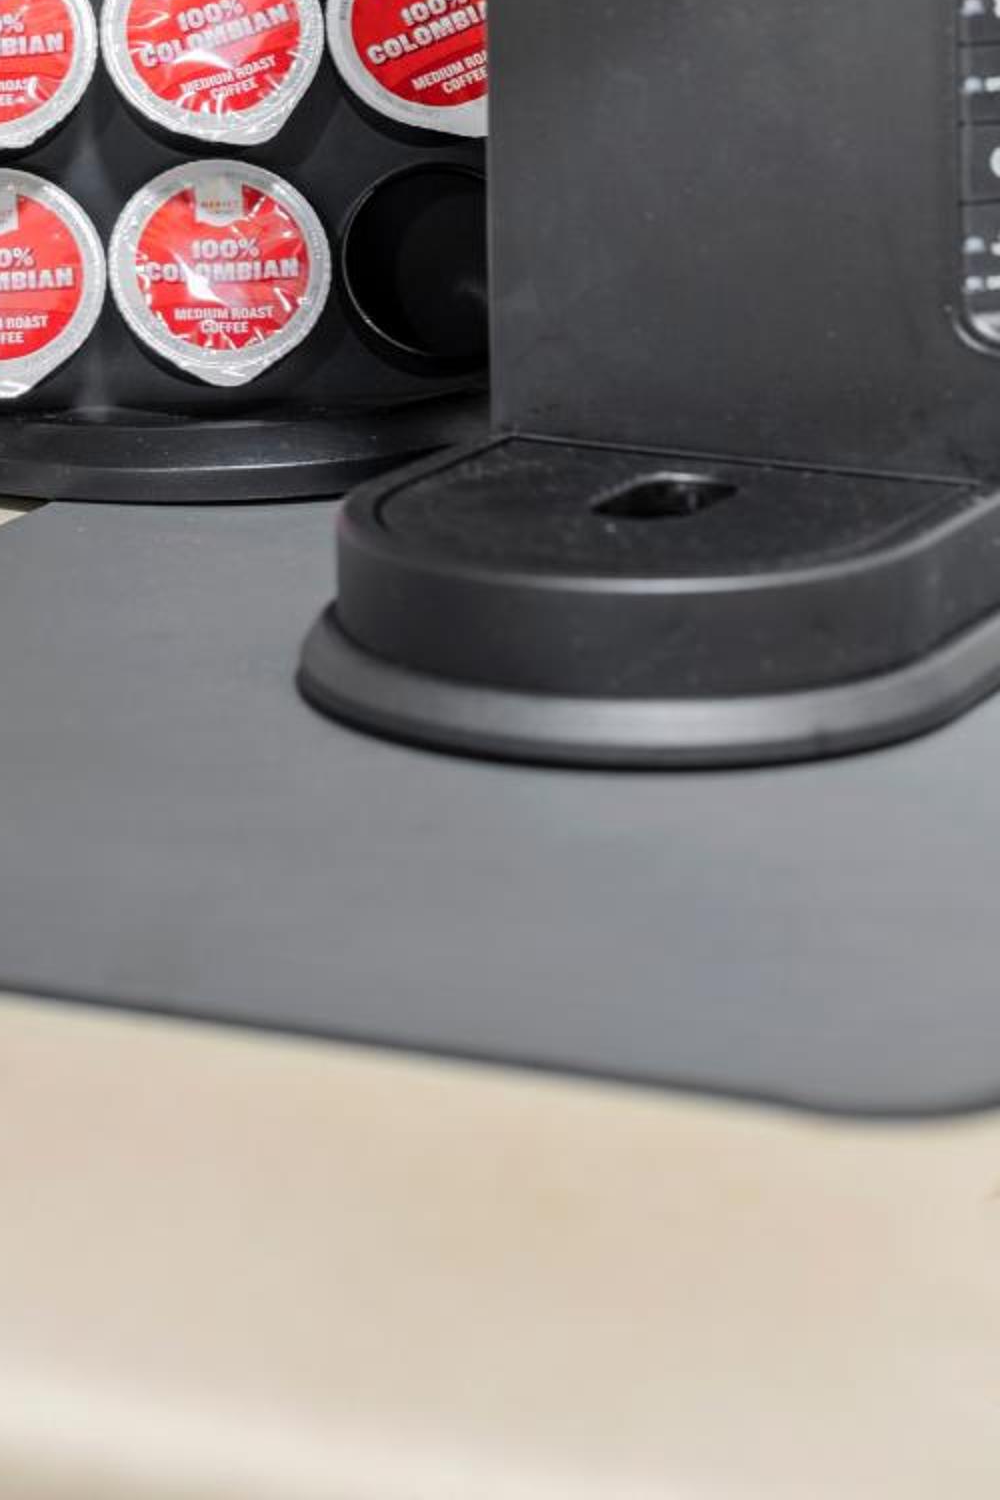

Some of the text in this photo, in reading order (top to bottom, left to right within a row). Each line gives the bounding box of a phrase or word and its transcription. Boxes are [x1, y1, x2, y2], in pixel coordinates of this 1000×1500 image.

[140, 3, 289, 67] COLOMBIAN
[366, 3, 486, 65] COLOMBI
[180, 56, 277, 95] MEDIUM ROAST
[411, 61, 464, 91] MEDIUM
[210, 78, 258, 99] COFFEE
[191, 238, 260, 260] 100%
[6, 314, 48, 330] ROAST
[174, 305, 274, 321] MEDIUM ROAST
[200, 320, 249, 335] COFFEE
